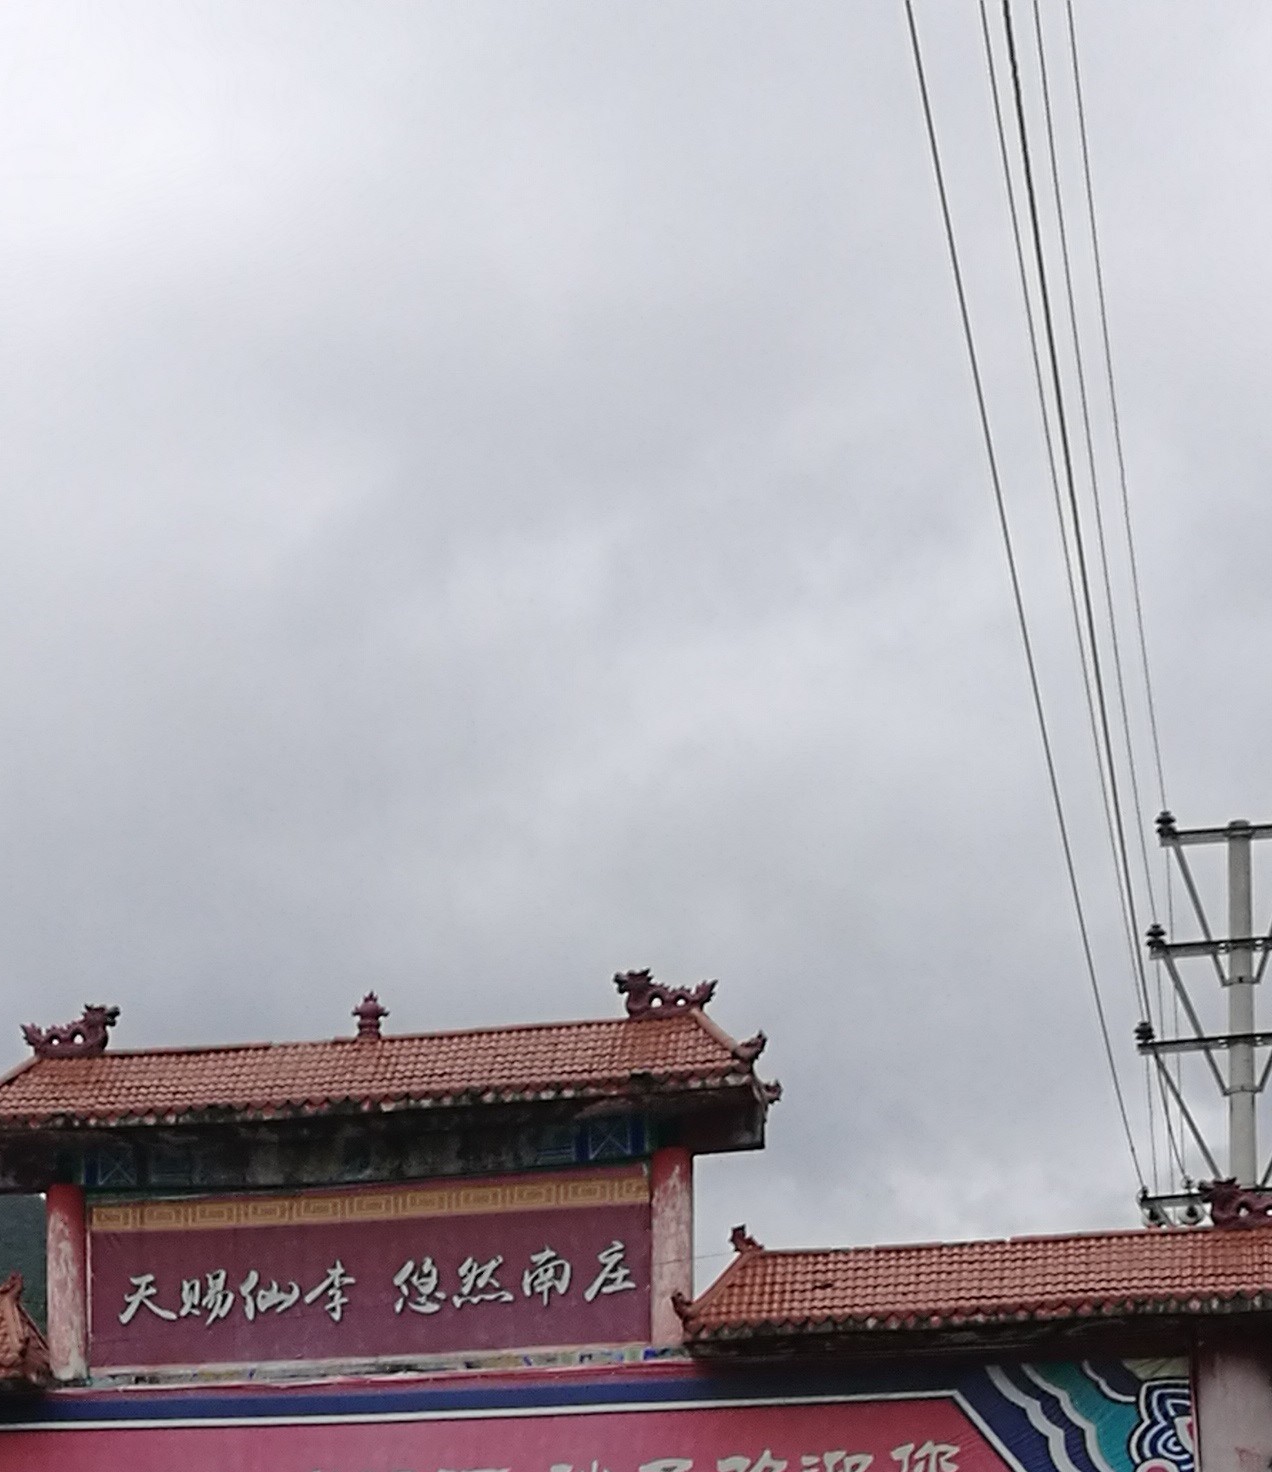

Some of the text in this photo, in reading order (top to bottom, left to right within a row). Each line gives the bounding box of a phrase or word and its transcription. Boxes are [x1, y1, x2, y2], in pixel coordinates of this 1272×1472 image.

[118, 1239, 637, 1327] 天赐仙李 悠然南庄
